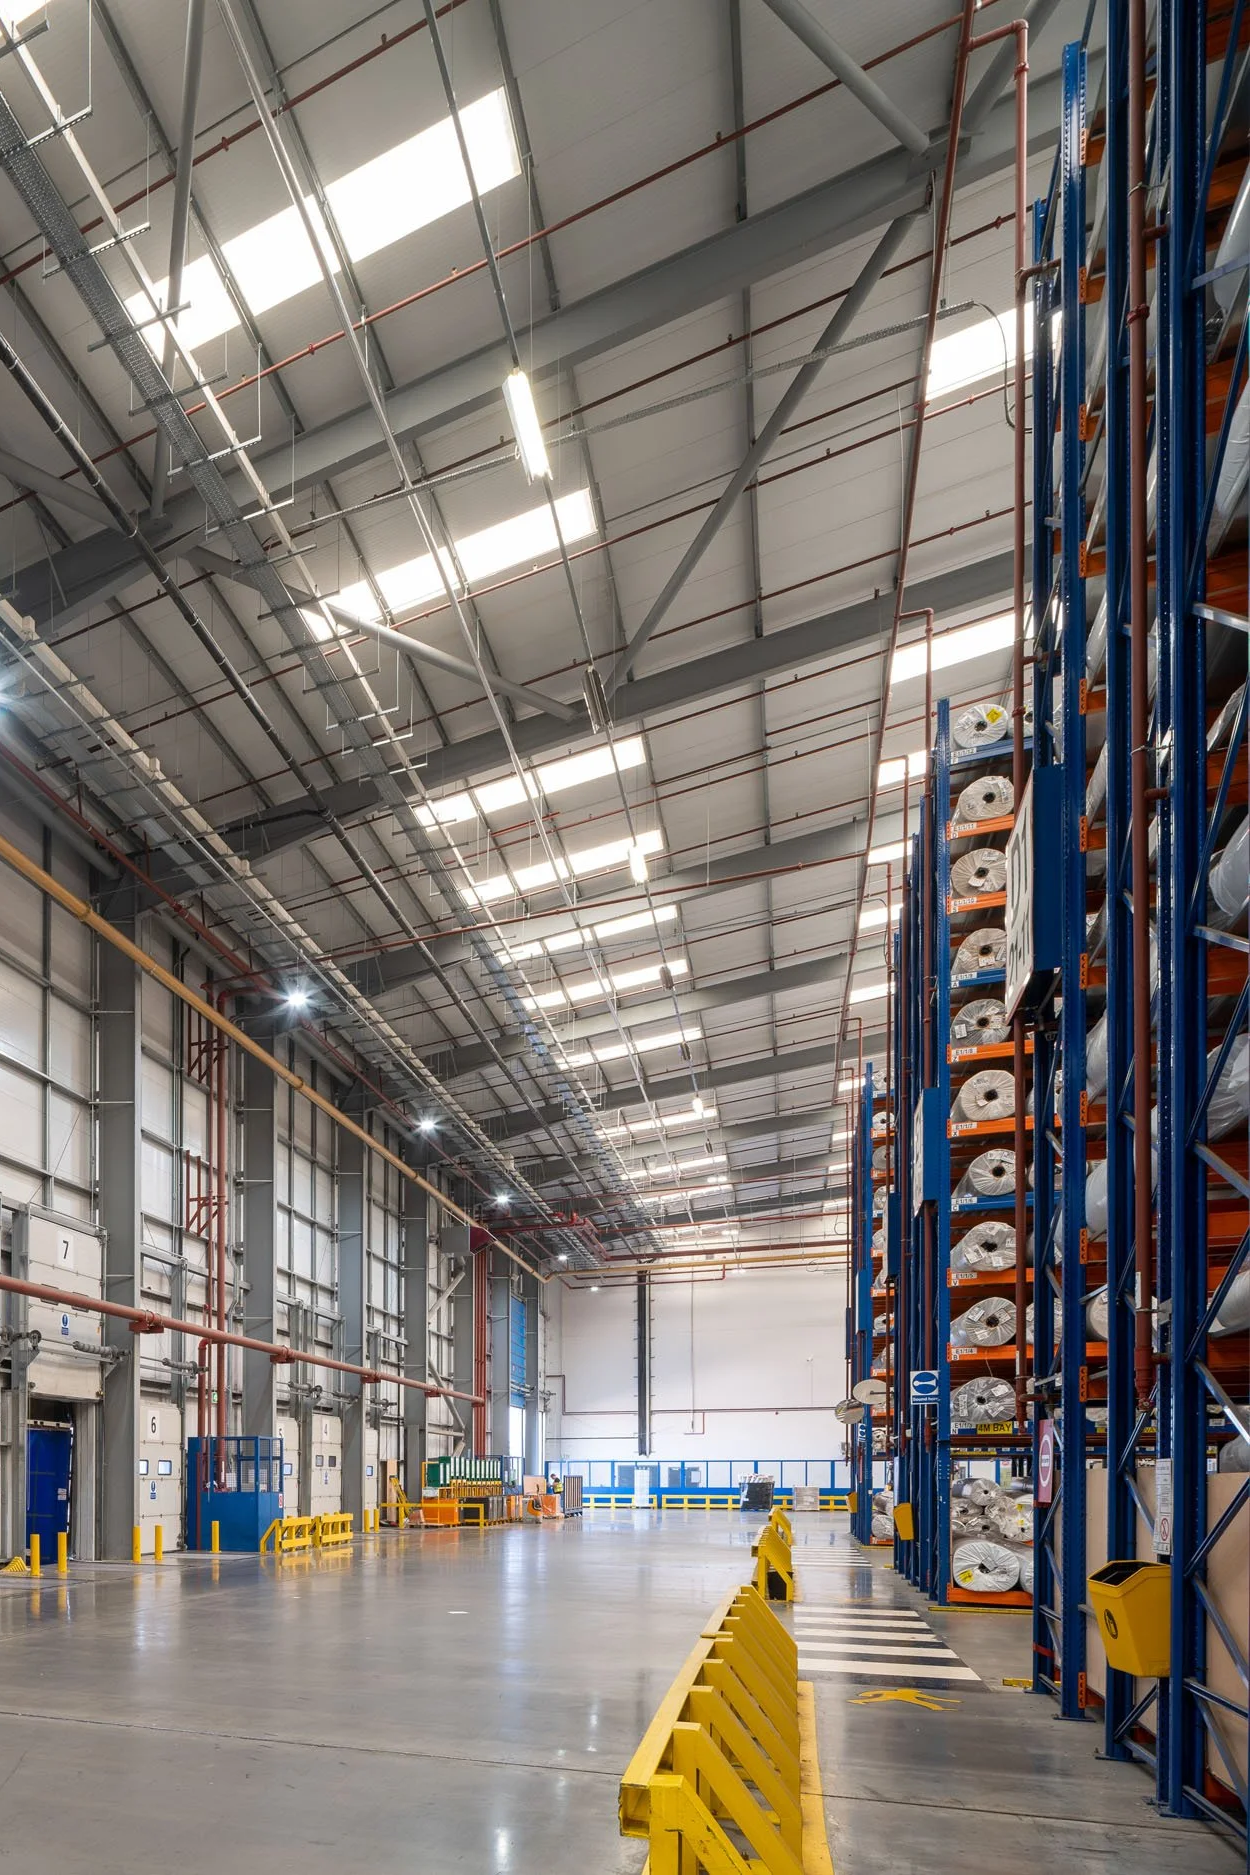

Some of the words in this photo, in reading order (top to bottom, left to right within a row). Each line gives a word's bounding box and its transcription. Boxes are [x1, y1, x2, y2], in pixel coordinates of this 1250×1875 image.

[1011, 807, 1028, 929] D1
[62, 1240, 69, 1259] 7
[151, 1416, 156, 1433] 6
[324, 1423, 328, 1436] 4
[978, 1423, 990, 1432] 4M
[993, 1423, 1011, 1432] BAY
